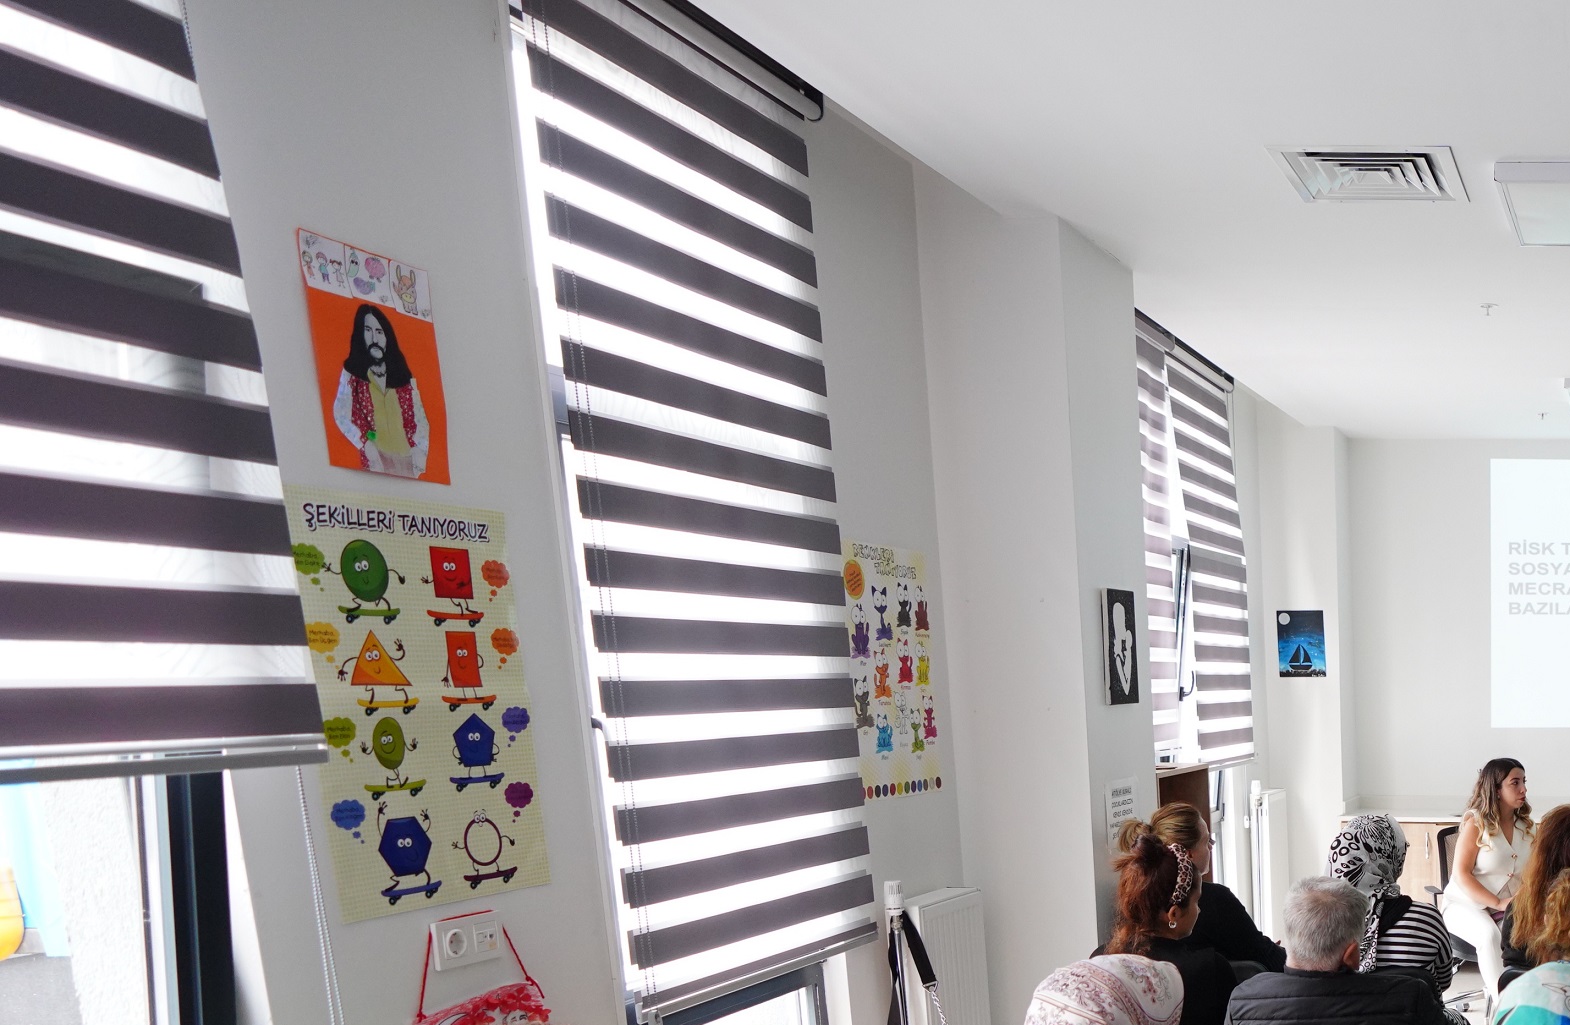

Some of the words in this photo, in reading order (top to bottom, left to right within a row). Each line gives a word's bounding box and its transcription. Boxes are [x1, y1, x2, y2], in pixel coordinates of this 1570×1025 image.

[303, 503, 395, 532] ŞEKİLLERİ
[398, 514, 490, 543] TANIYORUZ
[1508, 539, 1555, 555] RİSK
